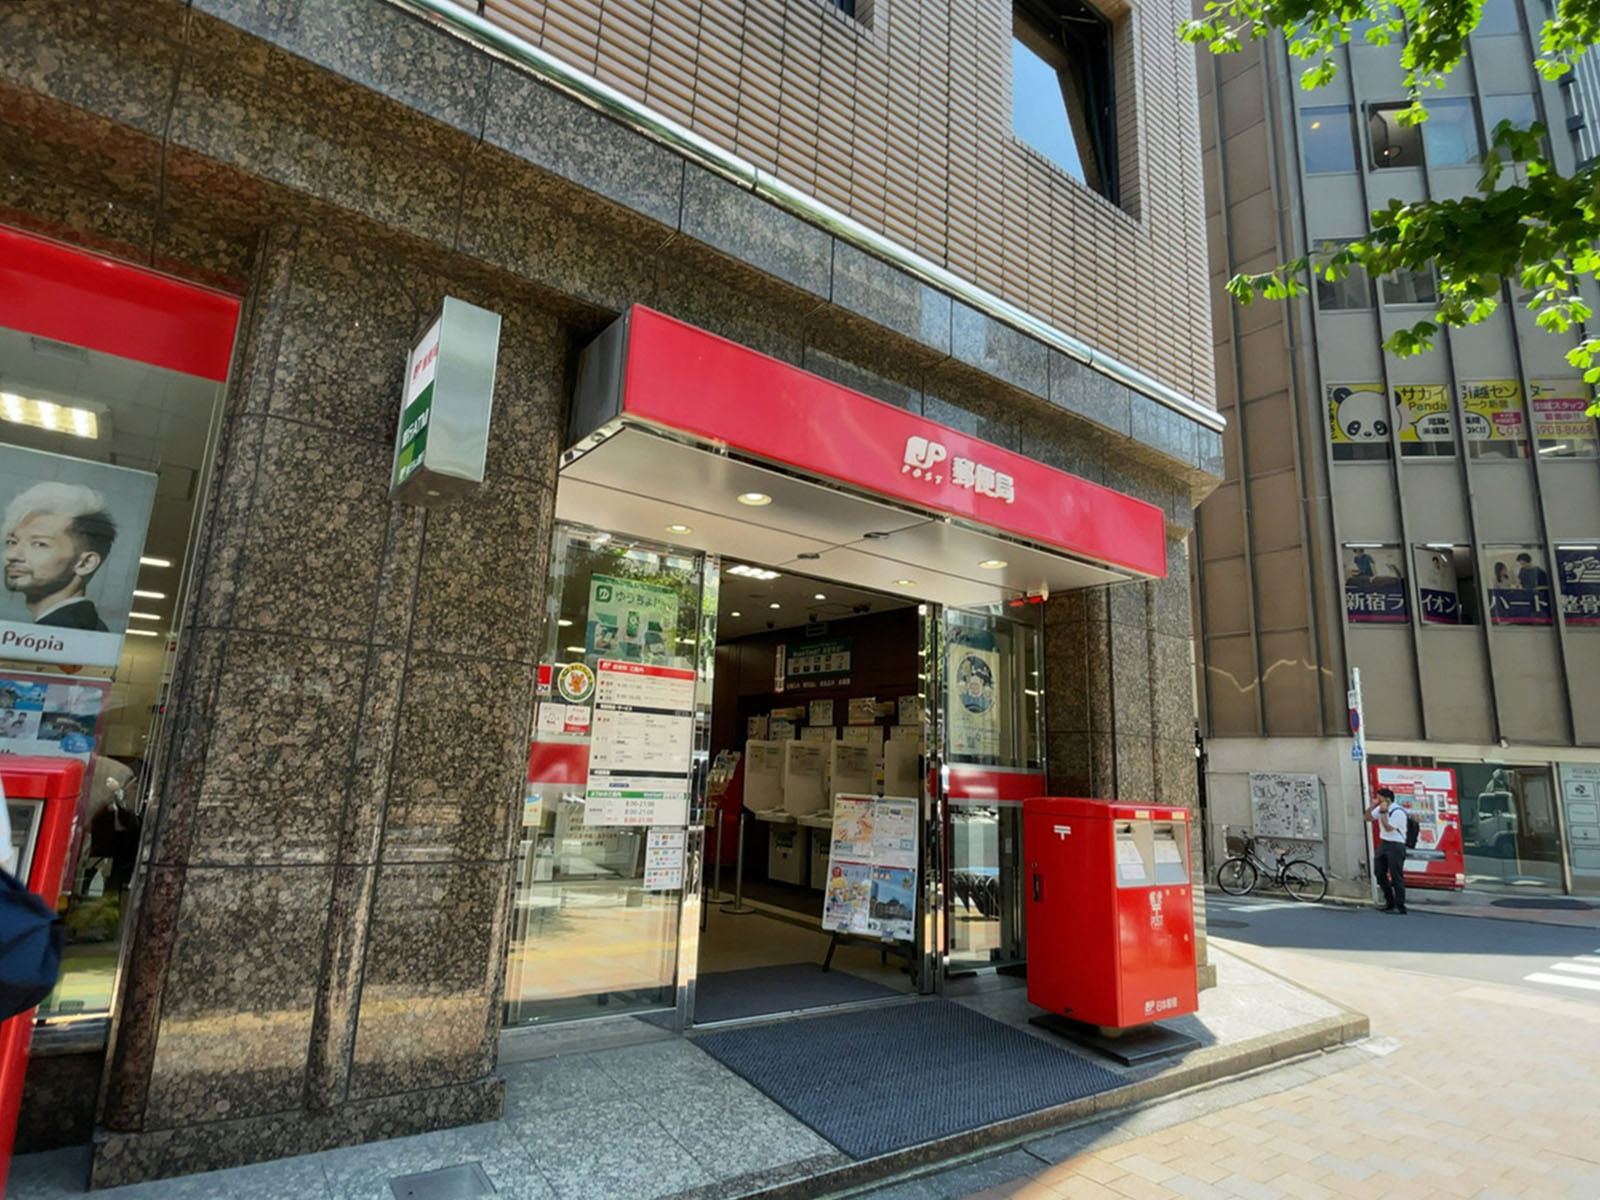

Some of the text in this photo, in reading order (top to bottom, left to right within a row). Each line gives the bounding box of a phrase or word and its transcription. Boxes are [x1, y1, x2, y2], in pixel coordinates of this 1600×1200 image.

[1402, 387, 1447, 401] サカイ
[1408, 402, 1449, 411] Panda
[901, 464, 943, 485] POST
[952, 457, 1015, 503] 郵便局
[1345, 592, 1405, 612] 新宿ラ
[1421, 593, 1463, 614] イオン
[1490, 594, 1549, 613] ハート
[2, 630, 65, 653] Propia
